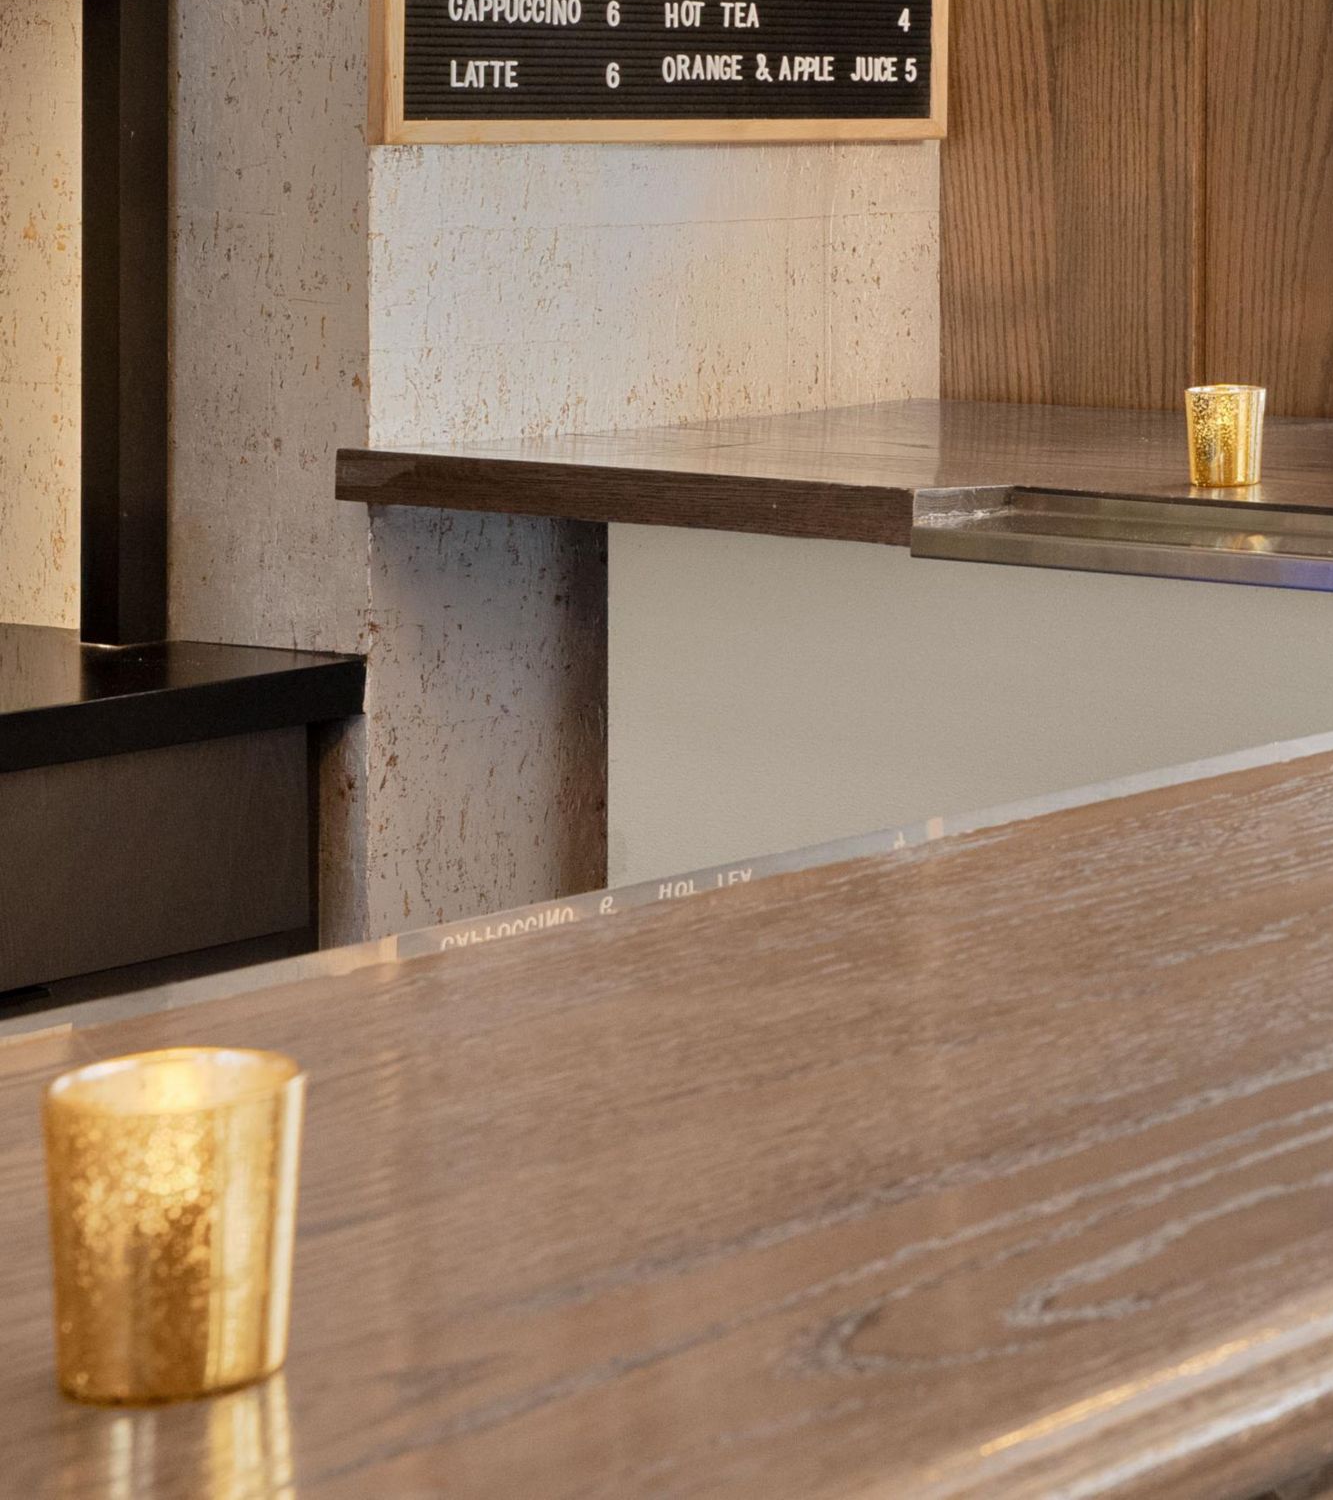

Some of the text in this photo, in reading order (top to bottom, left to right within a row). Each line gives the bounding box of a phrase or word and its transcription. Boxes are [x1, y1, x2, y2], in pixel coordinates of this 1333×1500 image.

[606, 0, 621, 27] 6
[664, 0, 911, 33] HOT TEA 4
[450, 59, 621, 89] LATTE 6
[661, 53, 918, 83] ORANGE & APPLE JUICE 5
